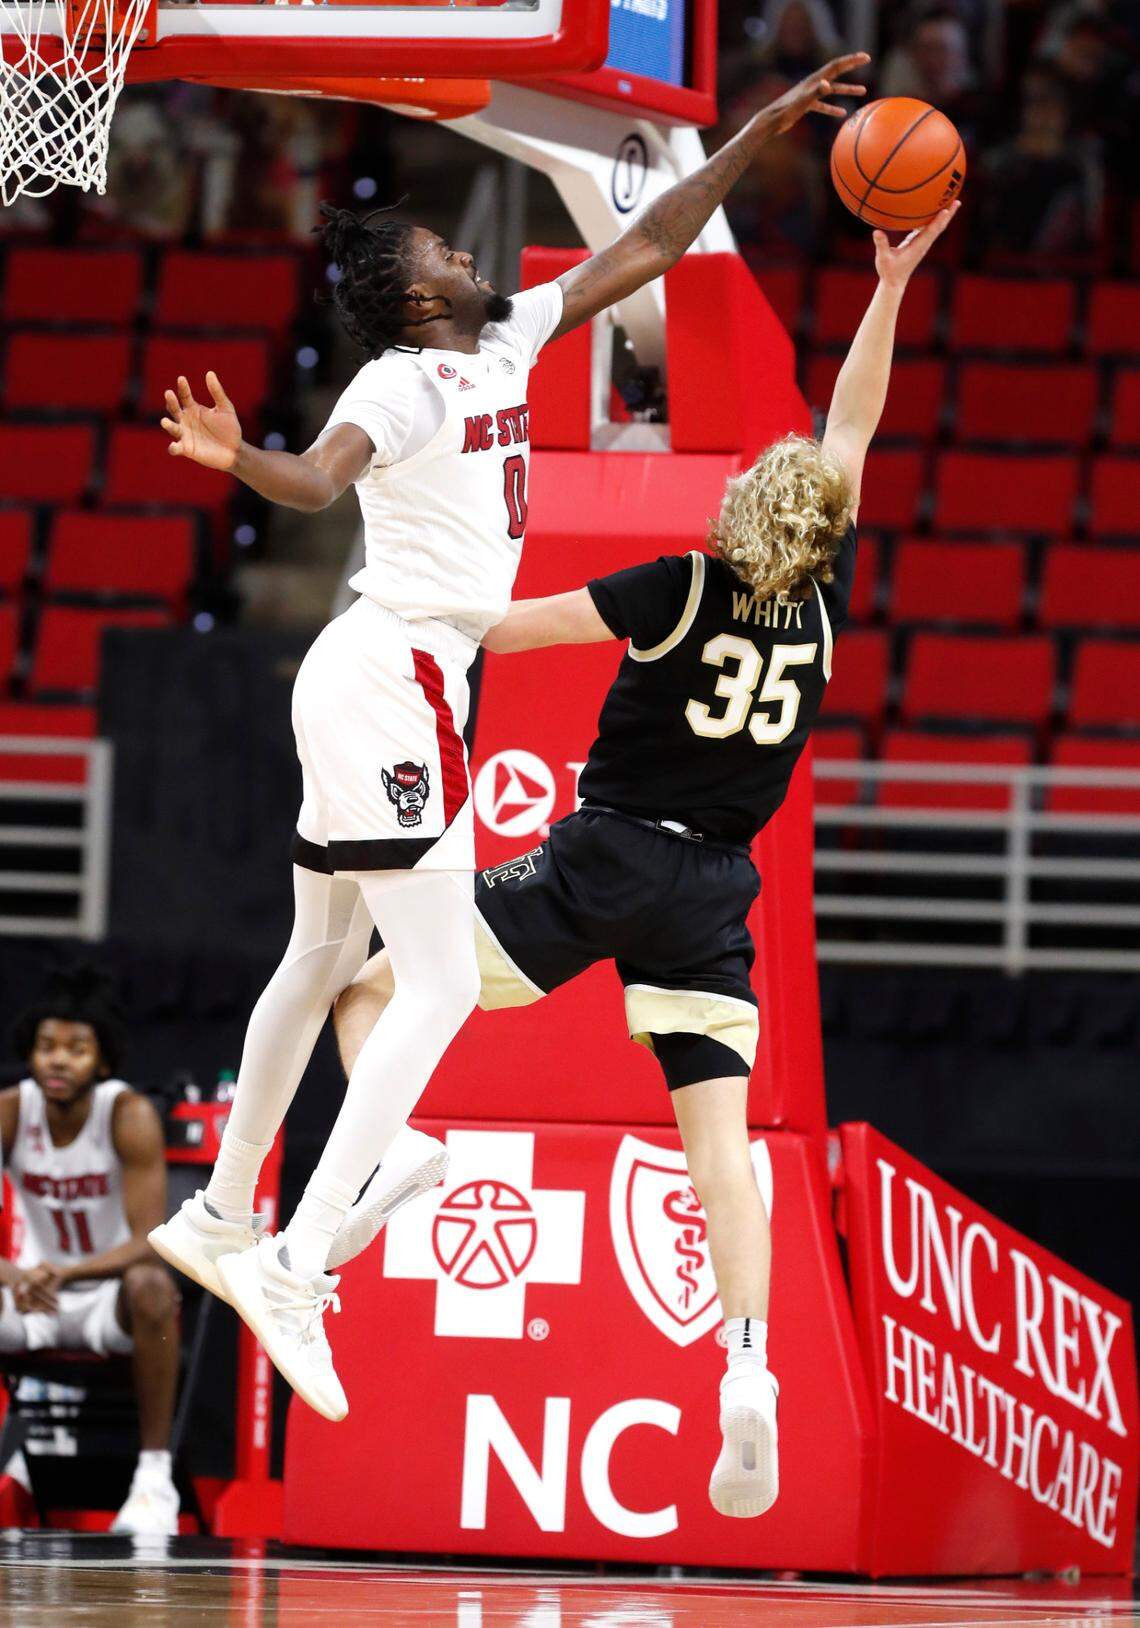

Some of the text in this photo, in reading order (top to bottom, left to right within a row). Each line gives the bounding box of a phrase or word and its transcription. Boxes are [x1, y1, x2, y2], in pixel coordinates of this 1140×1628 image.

[461, 414, 494, 453] NC
[503, 454, 528, 540] 0
[685, 632, 818, 745] 35
[50, 1207, 95, 1255] 11
[877, 1158, 1128, 1437] UNC REX
[460, 1394, 682, 1539] NC
[882, 1314, 1123, 1549] HEALTHCARE
